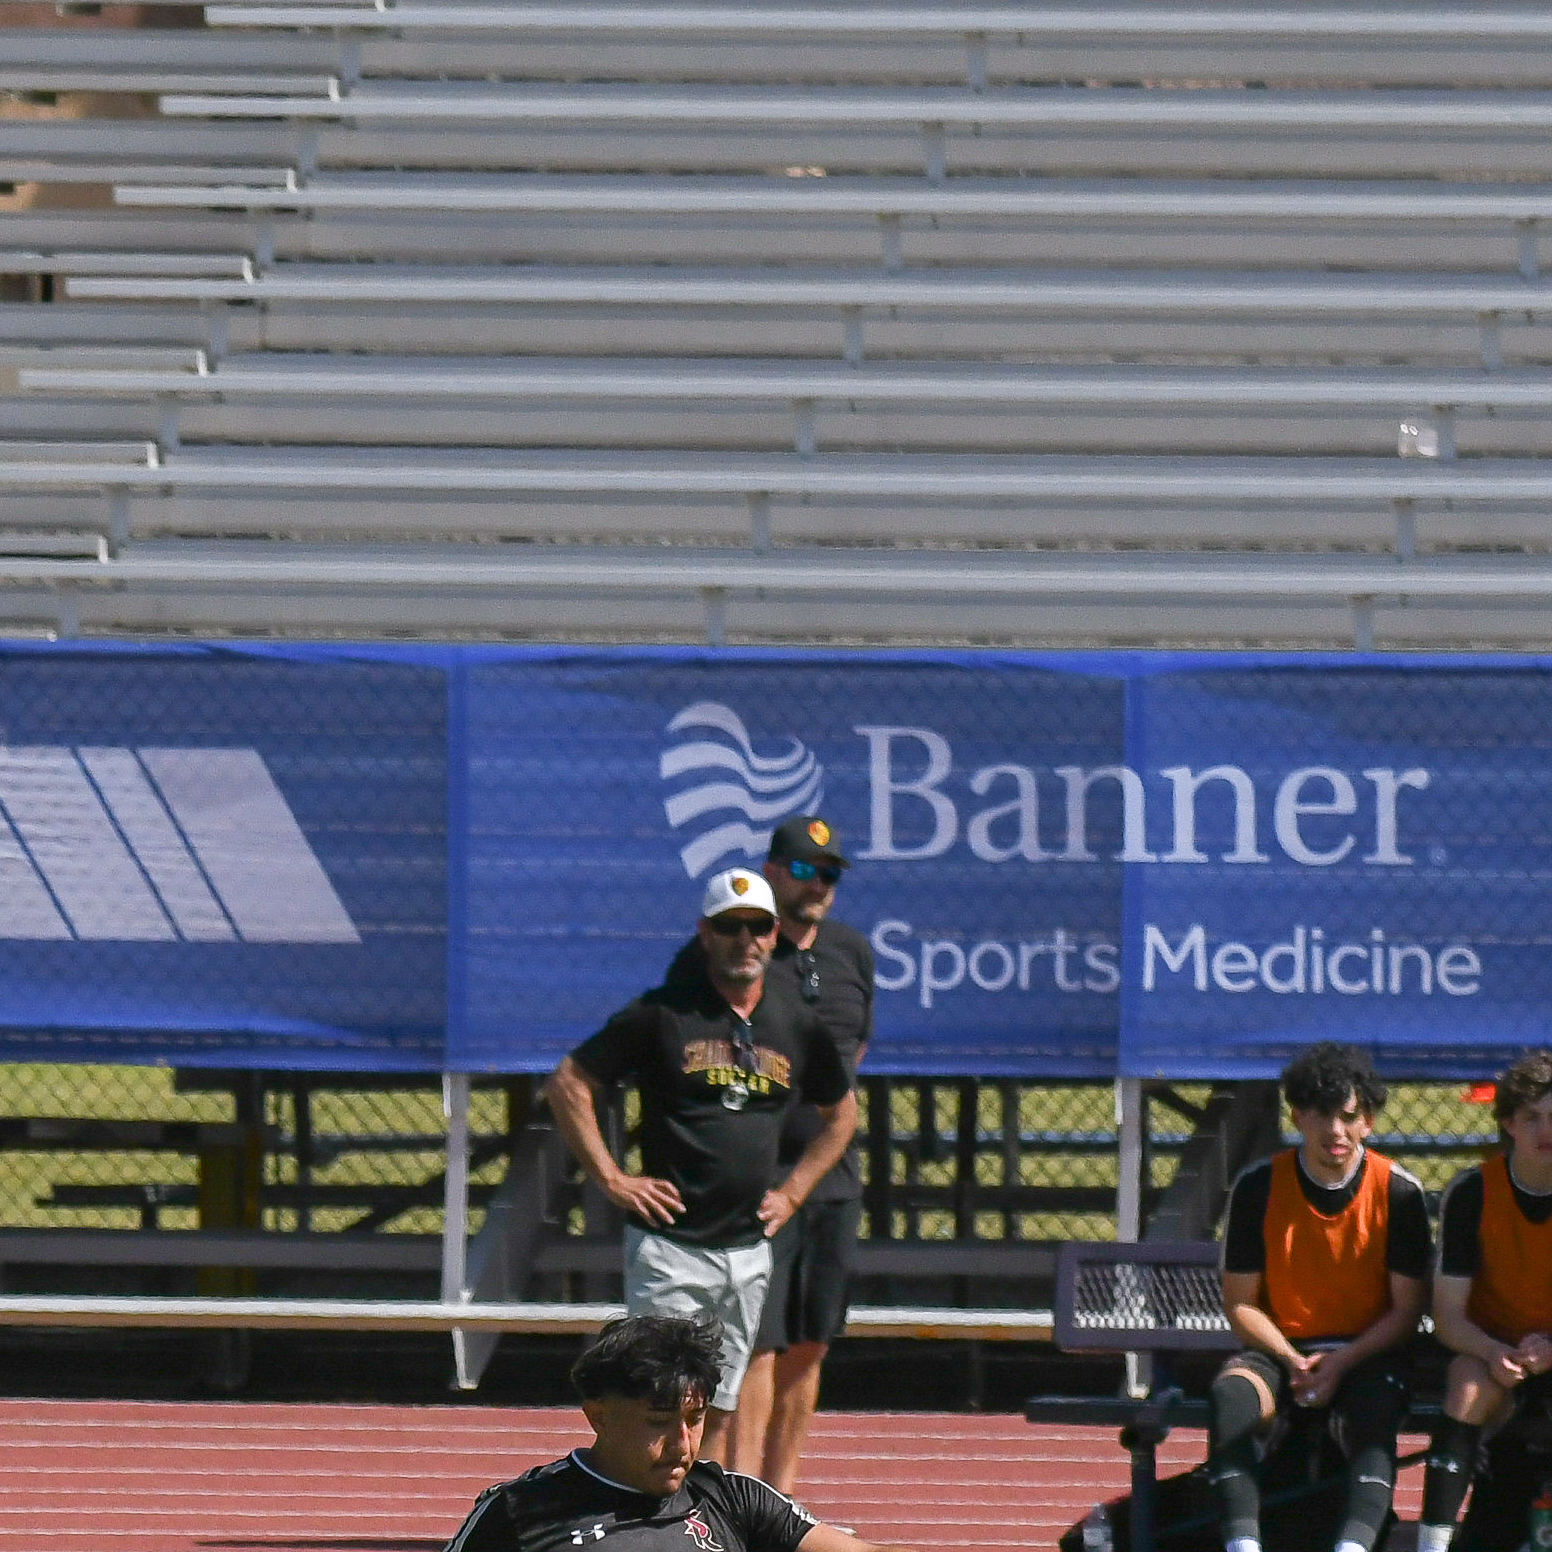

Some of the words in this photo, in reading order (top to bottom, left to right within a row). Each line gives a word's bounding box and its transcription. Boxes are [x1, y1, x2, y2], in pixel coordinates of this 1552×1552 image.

[854, 722, 1431, 866] Banner
[872, 921, 1120, 1006] Sports
[1143, 925, 1482, 998] Medicine
